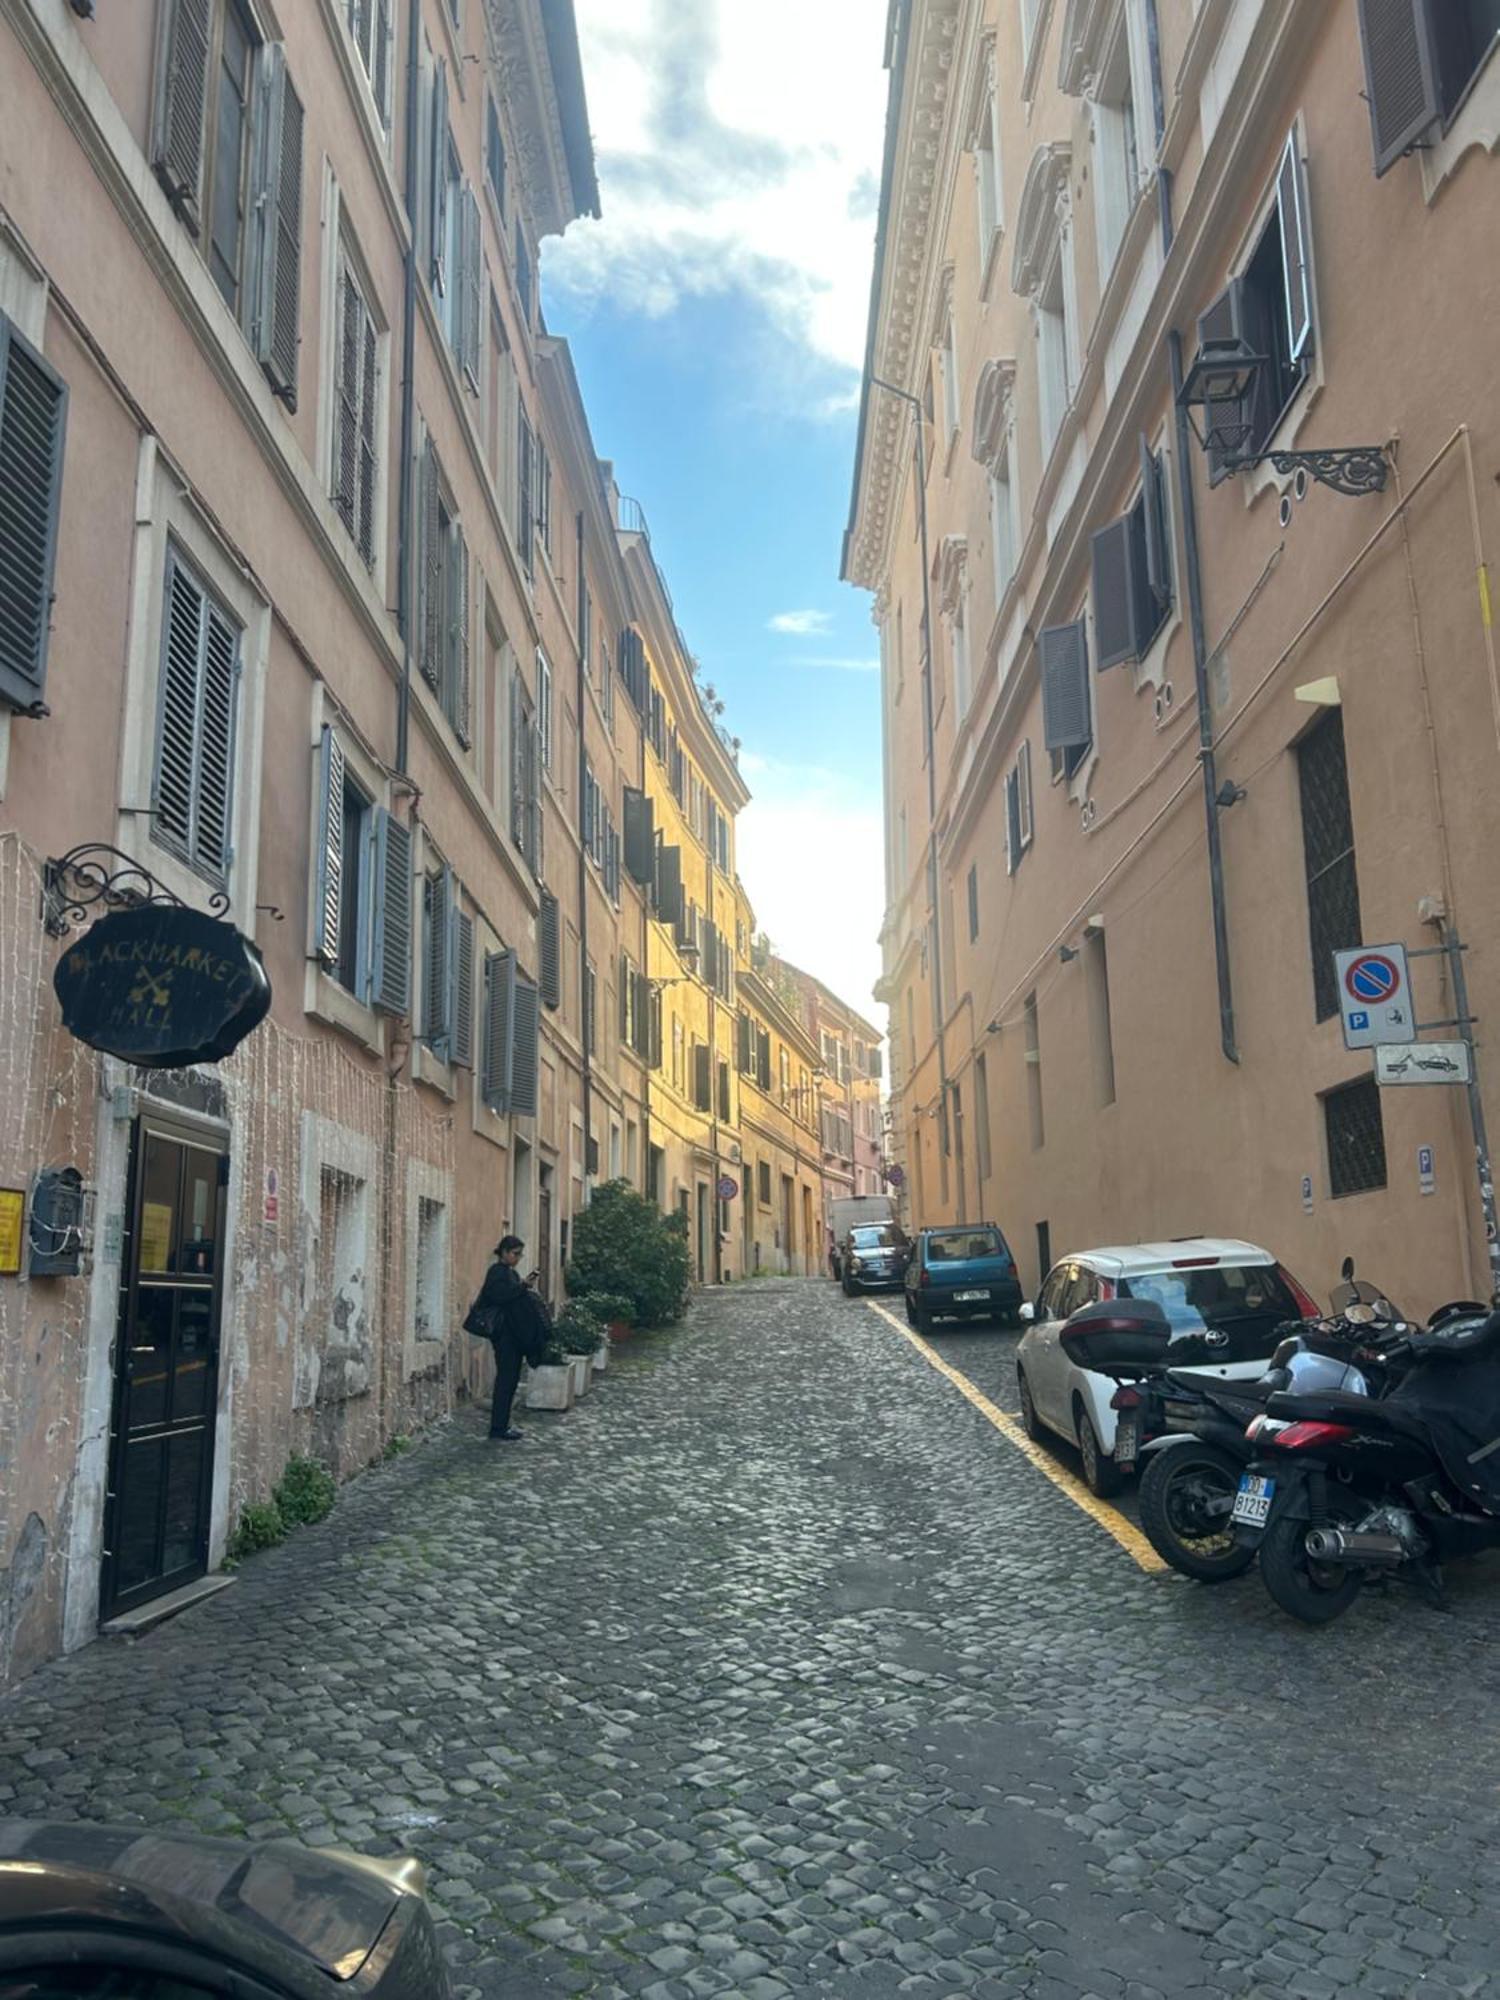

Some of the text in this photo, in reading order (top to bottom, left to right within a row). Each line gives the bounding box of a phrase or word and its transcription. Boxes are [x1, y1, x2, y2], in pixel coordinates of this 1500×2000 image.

[108, 1006, 172, 1030] HALL
[1353, 1016, 1364, 1028] P
[1421, 1151, 1430, 1172] P
